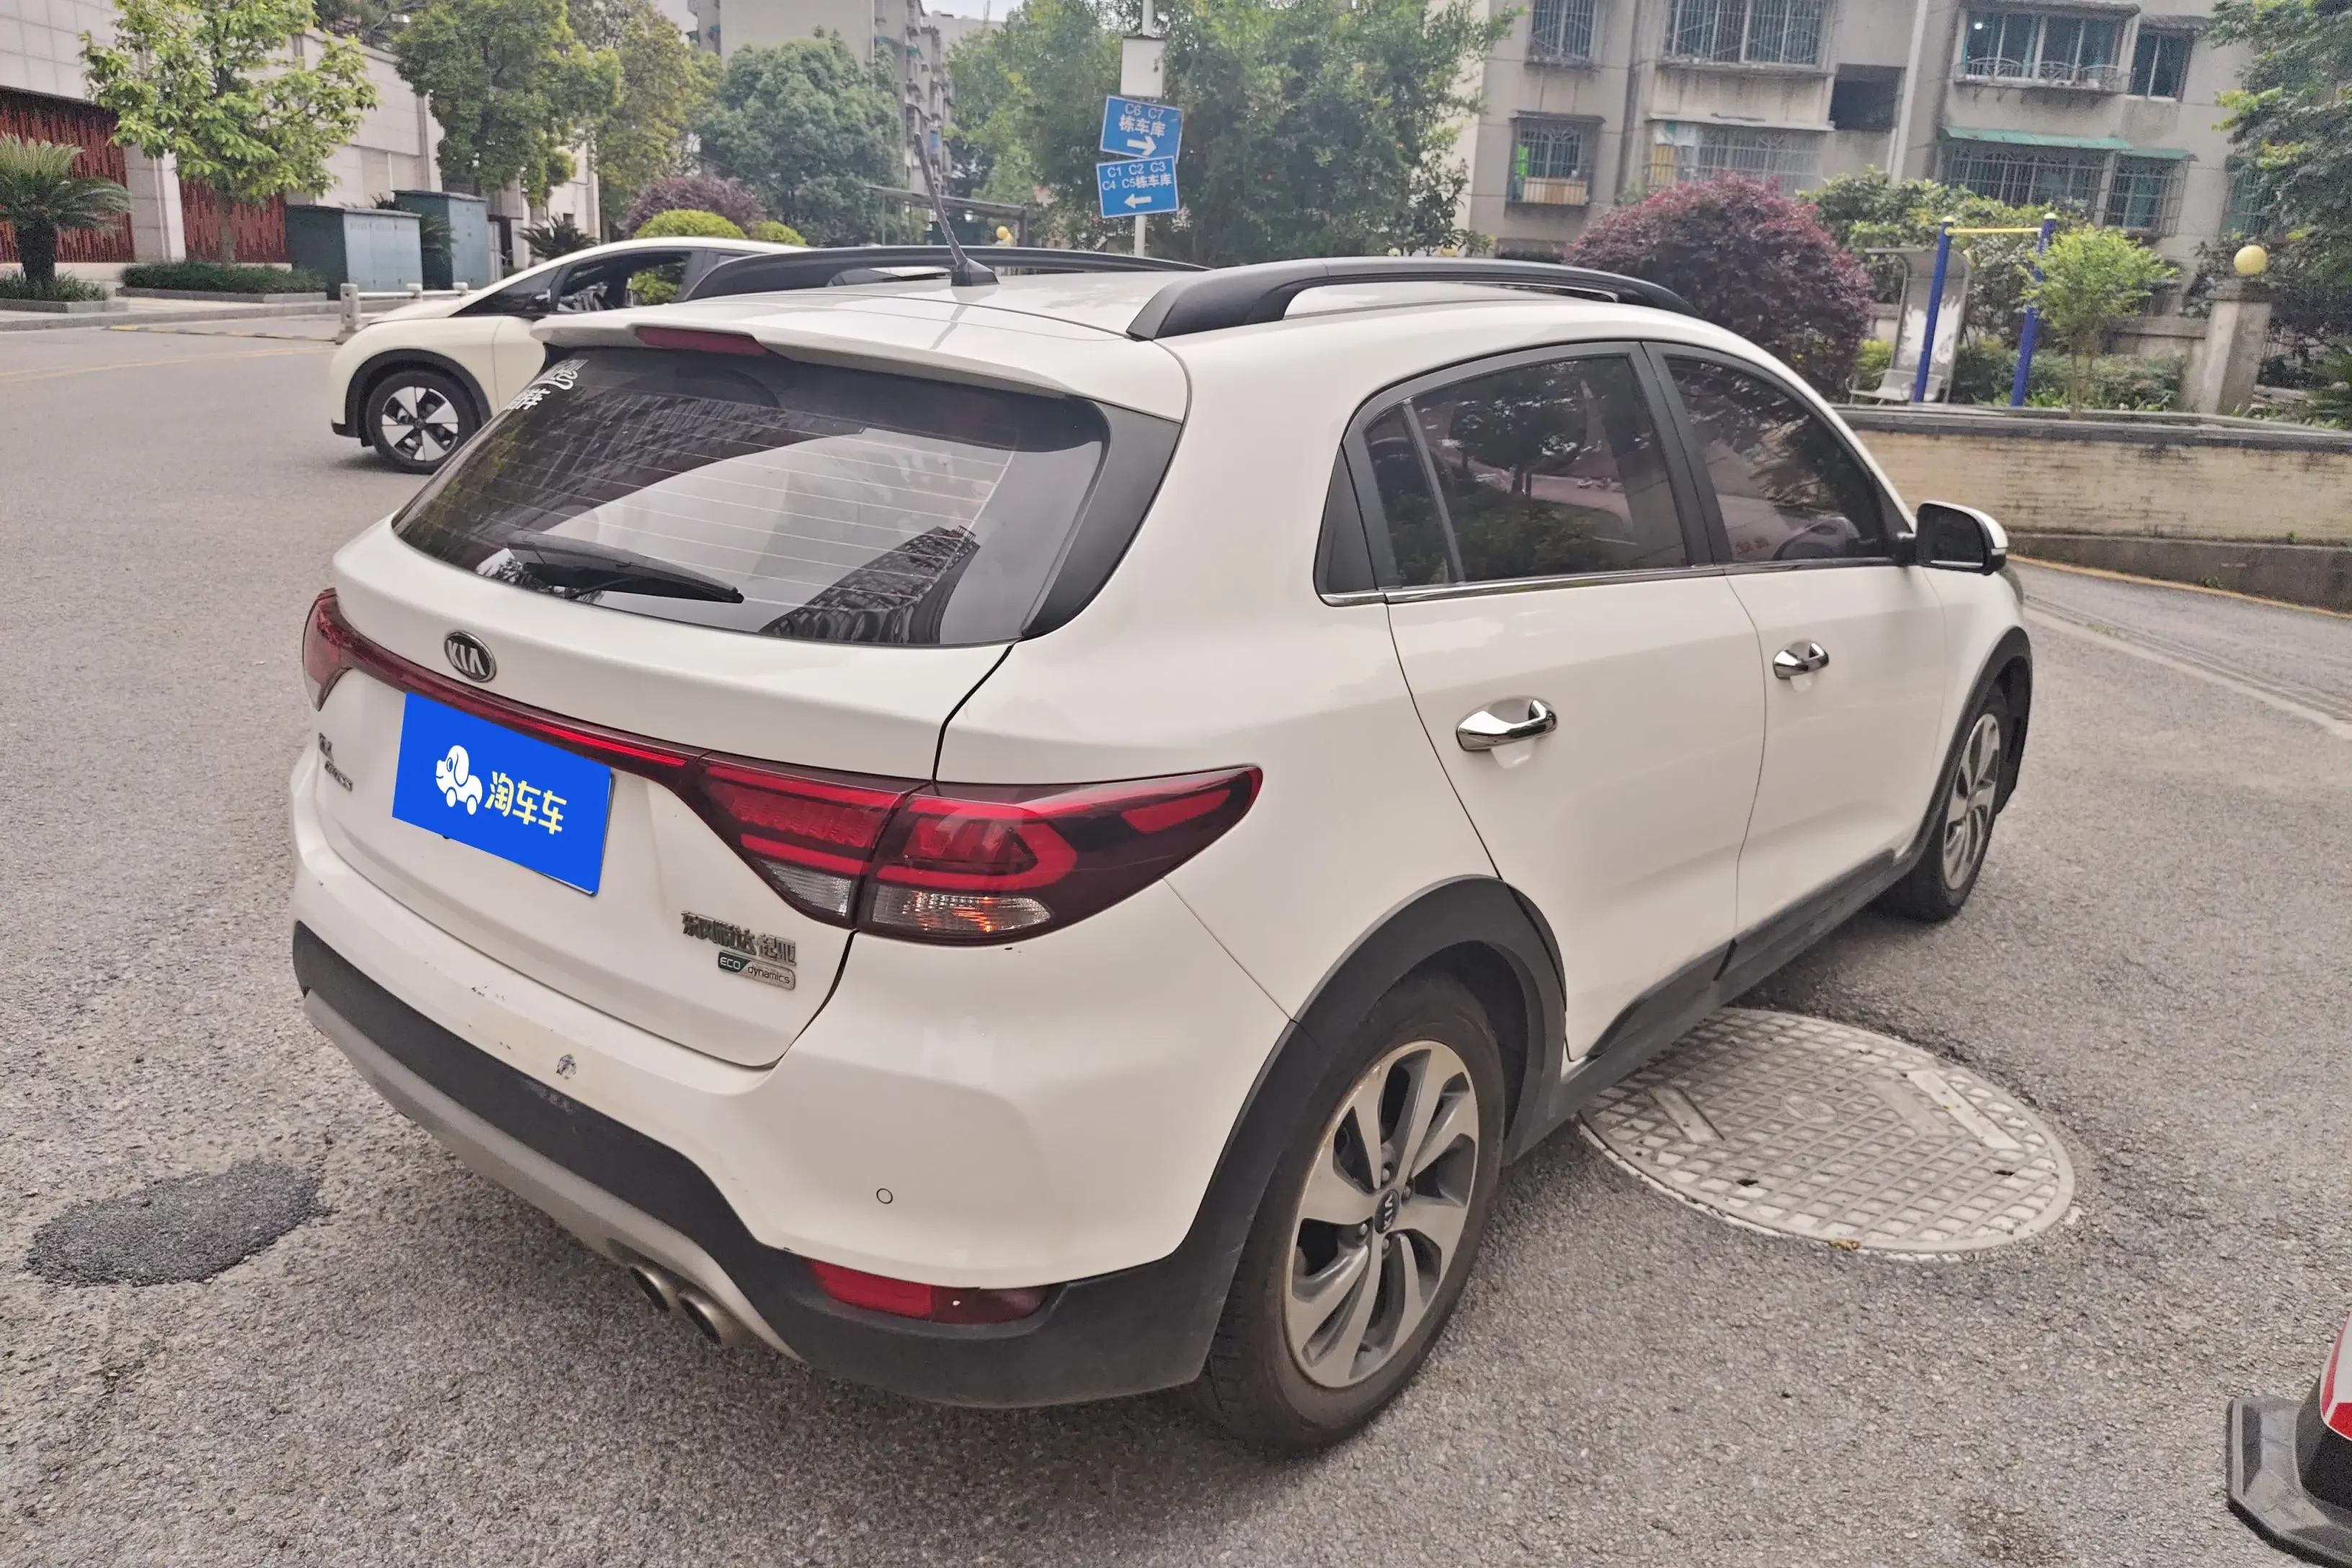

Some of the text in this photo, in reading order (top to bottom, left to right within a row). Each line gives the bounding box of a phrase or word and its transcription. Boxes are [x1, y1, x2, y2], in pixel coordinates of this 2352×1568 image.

[1120, 114, 1165, 137] 栋车库
[1148, 108, 1164, 120] C7
[1107, 161, 1167, 178] C1 C2 C3
[1102, 180, 1116, 190] C4
[447, 639, 486, 675] KIA
[720, 956, 790, 984] ECO dynamics
[1384, 1194, 1394, 1230] KIA
